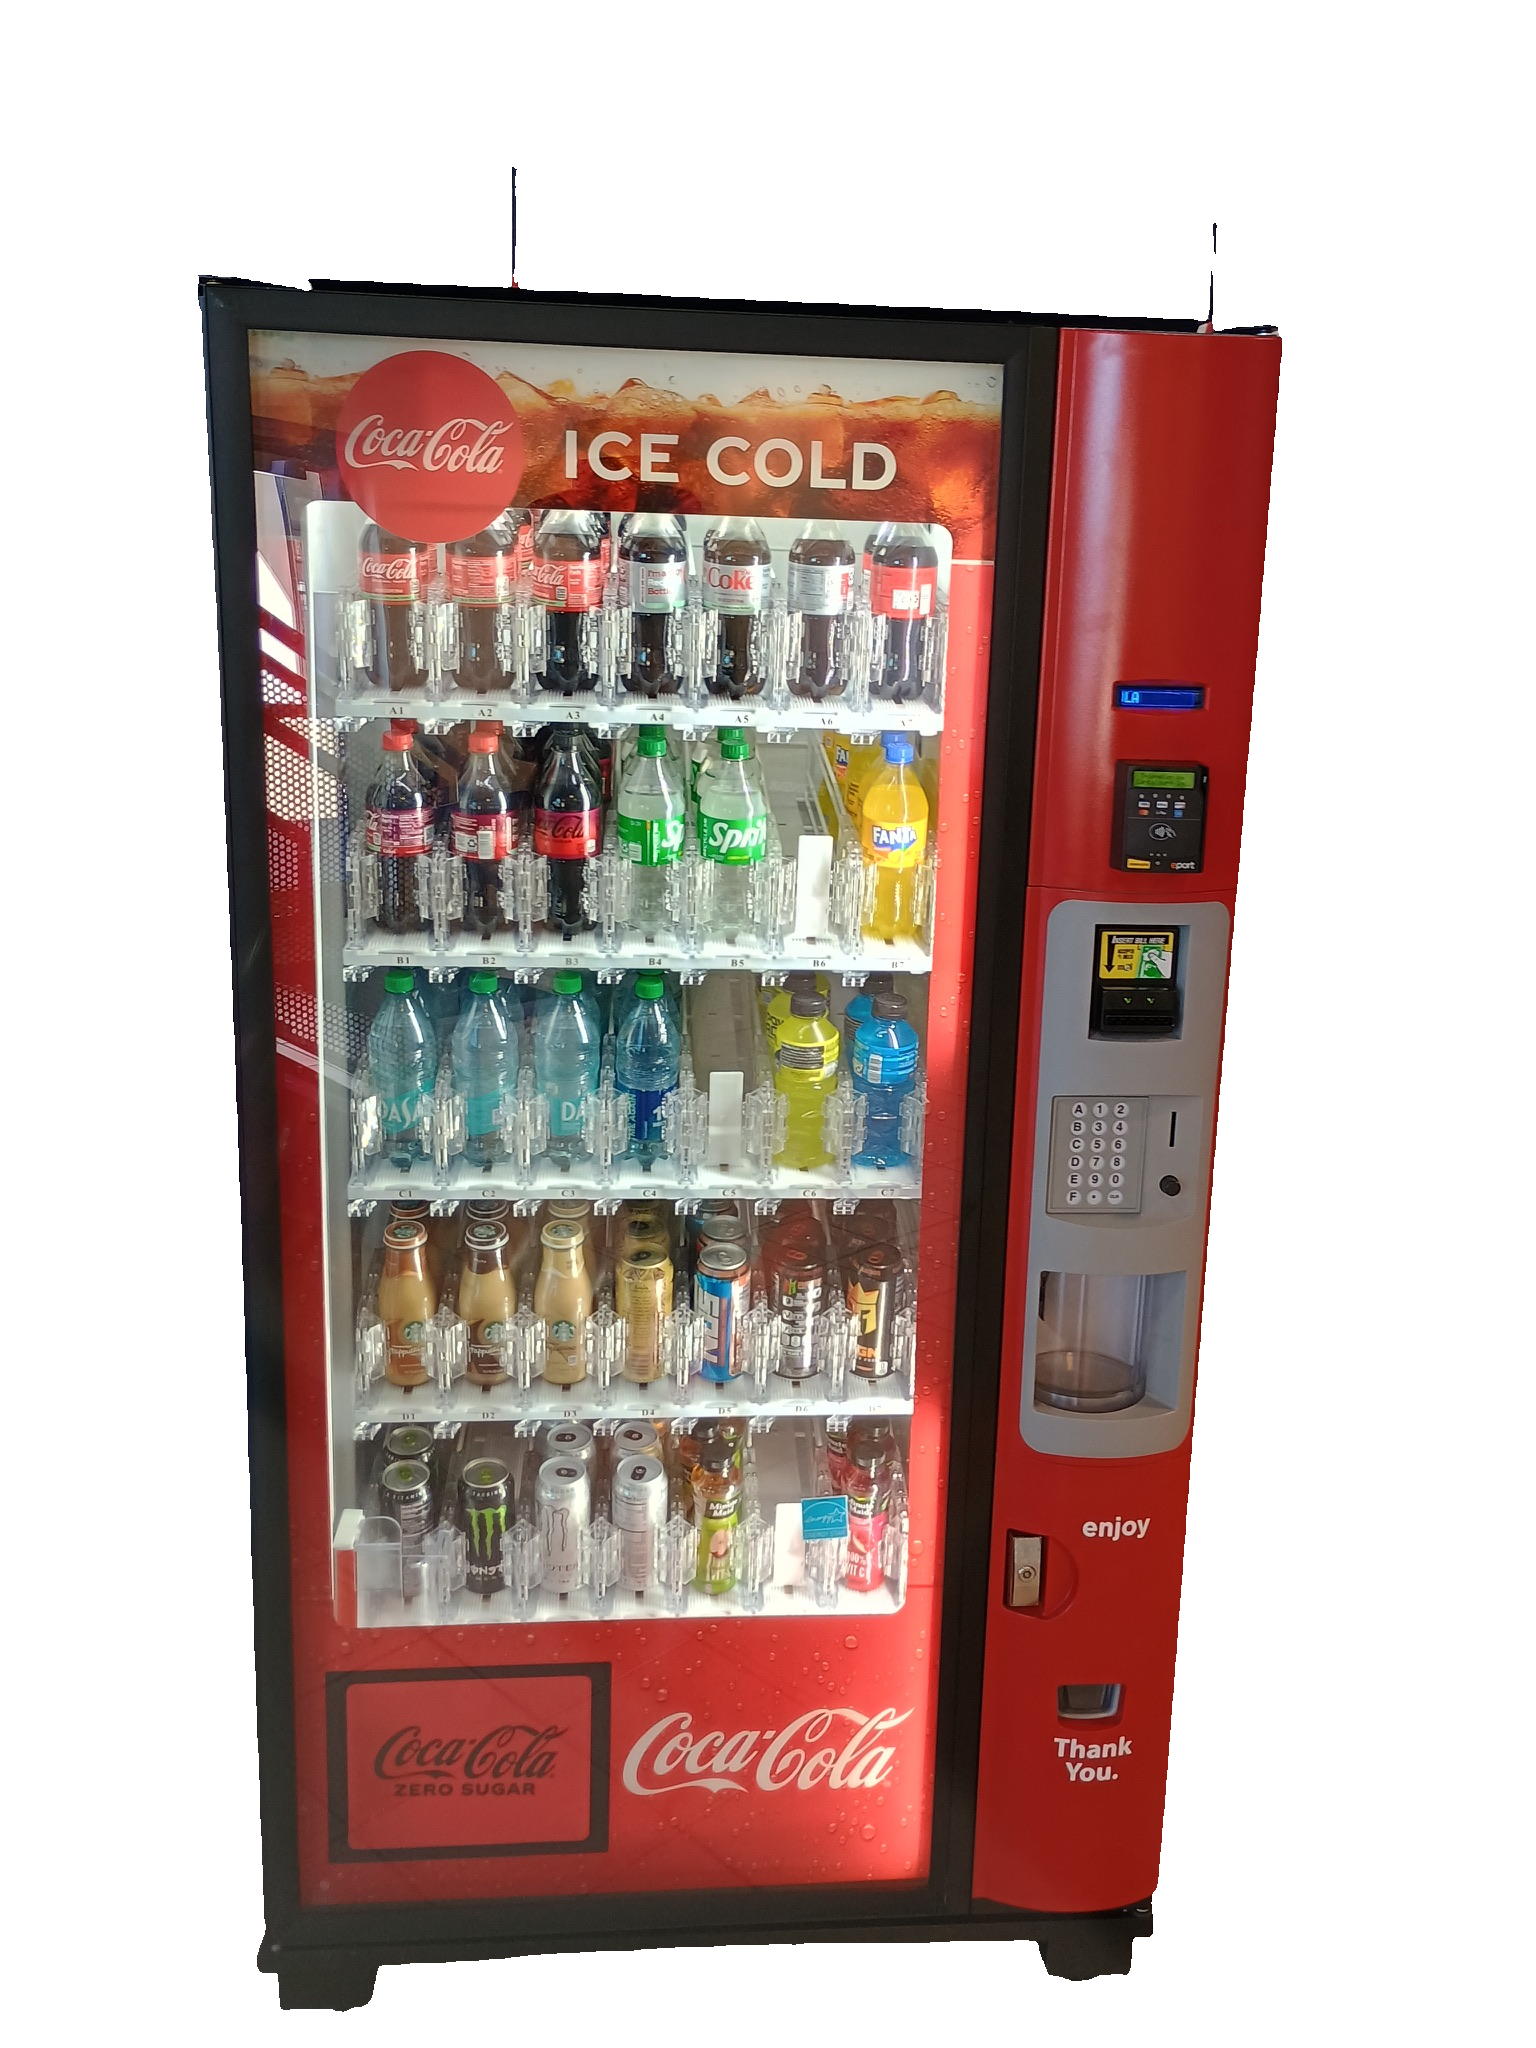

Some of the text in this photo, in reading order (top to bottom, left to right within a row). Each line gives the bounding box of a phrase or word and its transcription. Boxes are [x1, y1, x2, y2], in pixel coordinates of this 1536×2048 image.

[344, 414, 514, 474] Coca-Cola
[564, 430, 898, 491] ICE COLD
[389, 706, 404, 715] A1
[477, 708, 493, 717] A2
[565, 711, 581, 720] A3
[650, 712, 665, 722] A4
[734, 714, 749, 724] A5
[872, 825, 917, 845] FANTA
[396, 956, 410, 965] B1
[482, 956, 496, 966] B2
[565, 957, 579, 966] B3
[648, 957, 662, 966] B4
[730, 959, 745, 968] B5
[812, 959, 826, 968] B6
[1074, 1105, 1125, 1114] A 1 2
[1073, 1122, 1123, 1132] B 3 4
[1072, 1140, 1122, 1149] C 5 6
[1071, 1157, 1120, 1167] D 7 8
[1070, 1175, 1119, 1184] E 9 0
[399, 1190, 413, 1198] C1
[482, 1190, 496, 1198] C2
[561, 1189, 576, 1197] C3
[642, 1189, 657, 1198] C4
[722, 1189, 736, 1198] C5
[802, 1189, 817, 1198] C6
[880, 1188, 895, 1197] C7
[1069, 1192, 1077, 1201] F
[482, 1412, 496, 1420] D2
[563, 1410, 577, 1418] D3
[641, 1408, 655, 1417] D4
[718, 1407, 732, 1416] D5
[402, 1413, 416, 1421] D1
[1081, 1516, 1151, 1542] enjoy
[373, 1724, 570, 1780] Coca-Cola
[621, 1706, 915, 1796] Coca-Cola
[1053, 1736, 1133, 1760] Thank
[1065, 1761, 1119, 1783] You.
[394, 1781, 536, 1797] ZERO SUGAR
